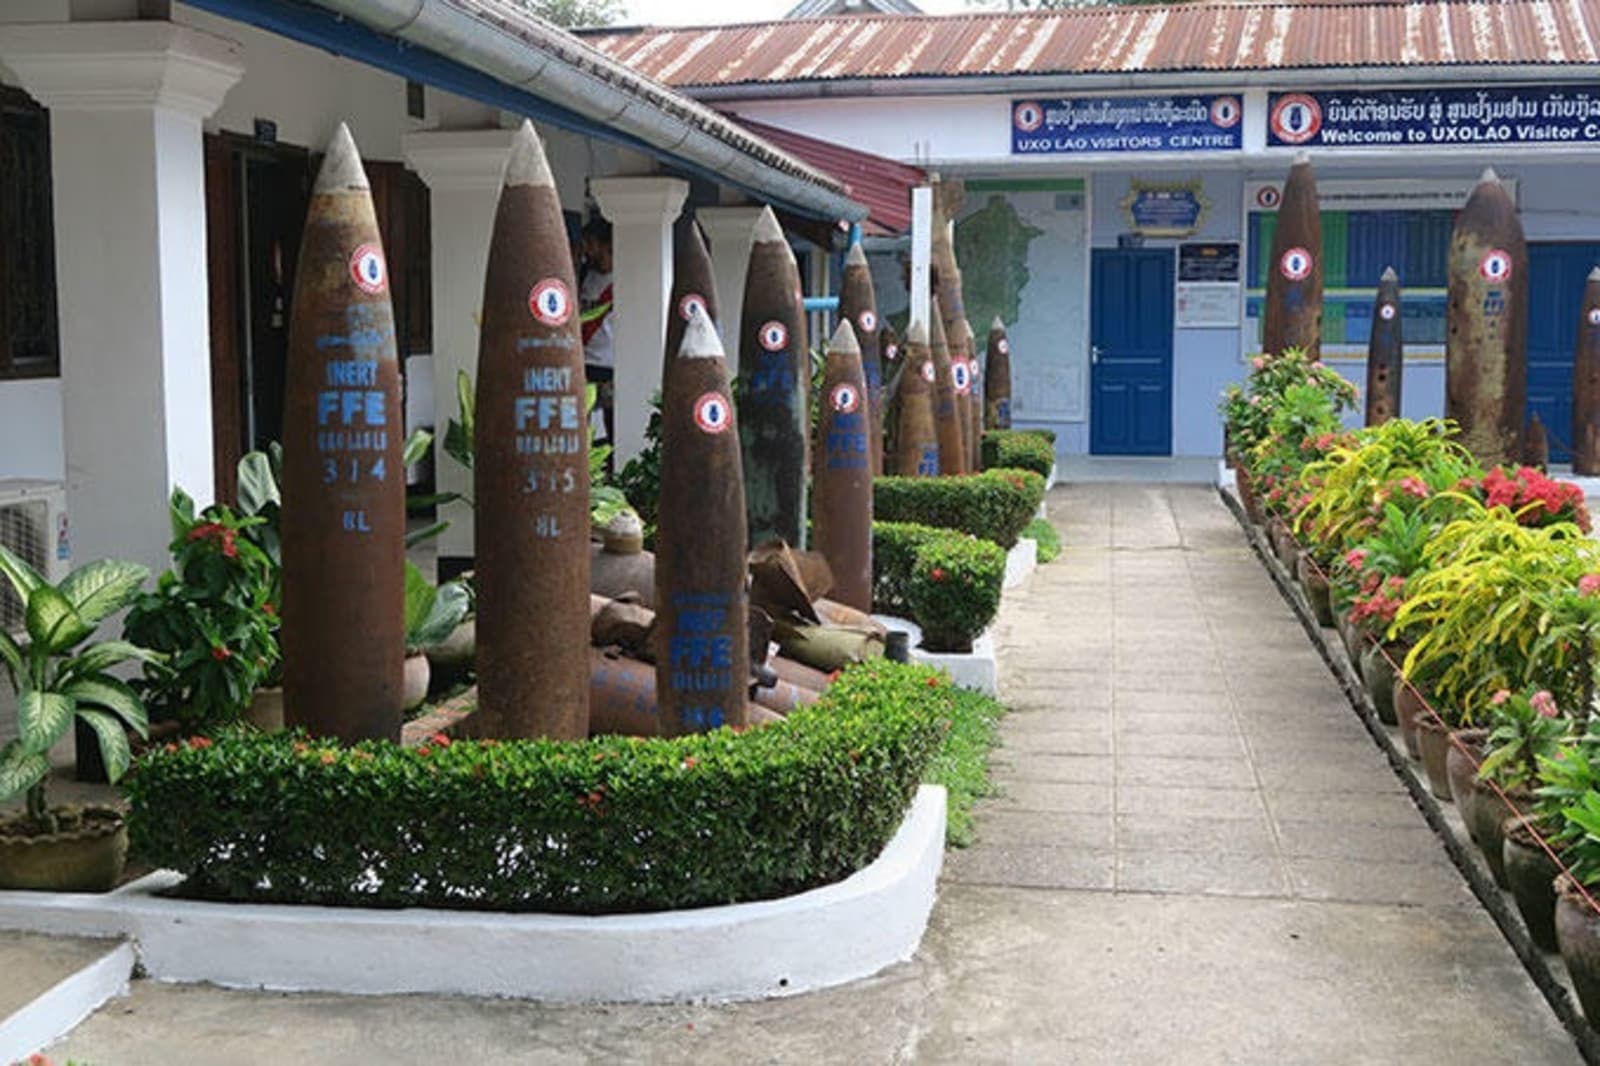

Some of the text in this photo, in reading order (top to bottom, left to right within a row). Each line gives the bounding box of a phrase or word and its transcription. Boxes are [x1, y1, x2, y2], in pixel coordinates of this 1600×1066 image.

[1018, 134, 1234, 151] UXO LAO VISITORS CENTRE
[1321, 128, 1403, 143] Welcome
[1408, 128, 1427, 141] to
[1432, 125, 1511, 141] UXOLAO
[1516, 124, 1580, 140] Visitor
[325, 360, 379, 386] INERT
[317, 391, 387, 426] FFE
[515, 396, 579, 430] FFE
[670, 635, 733, 669] FFE
